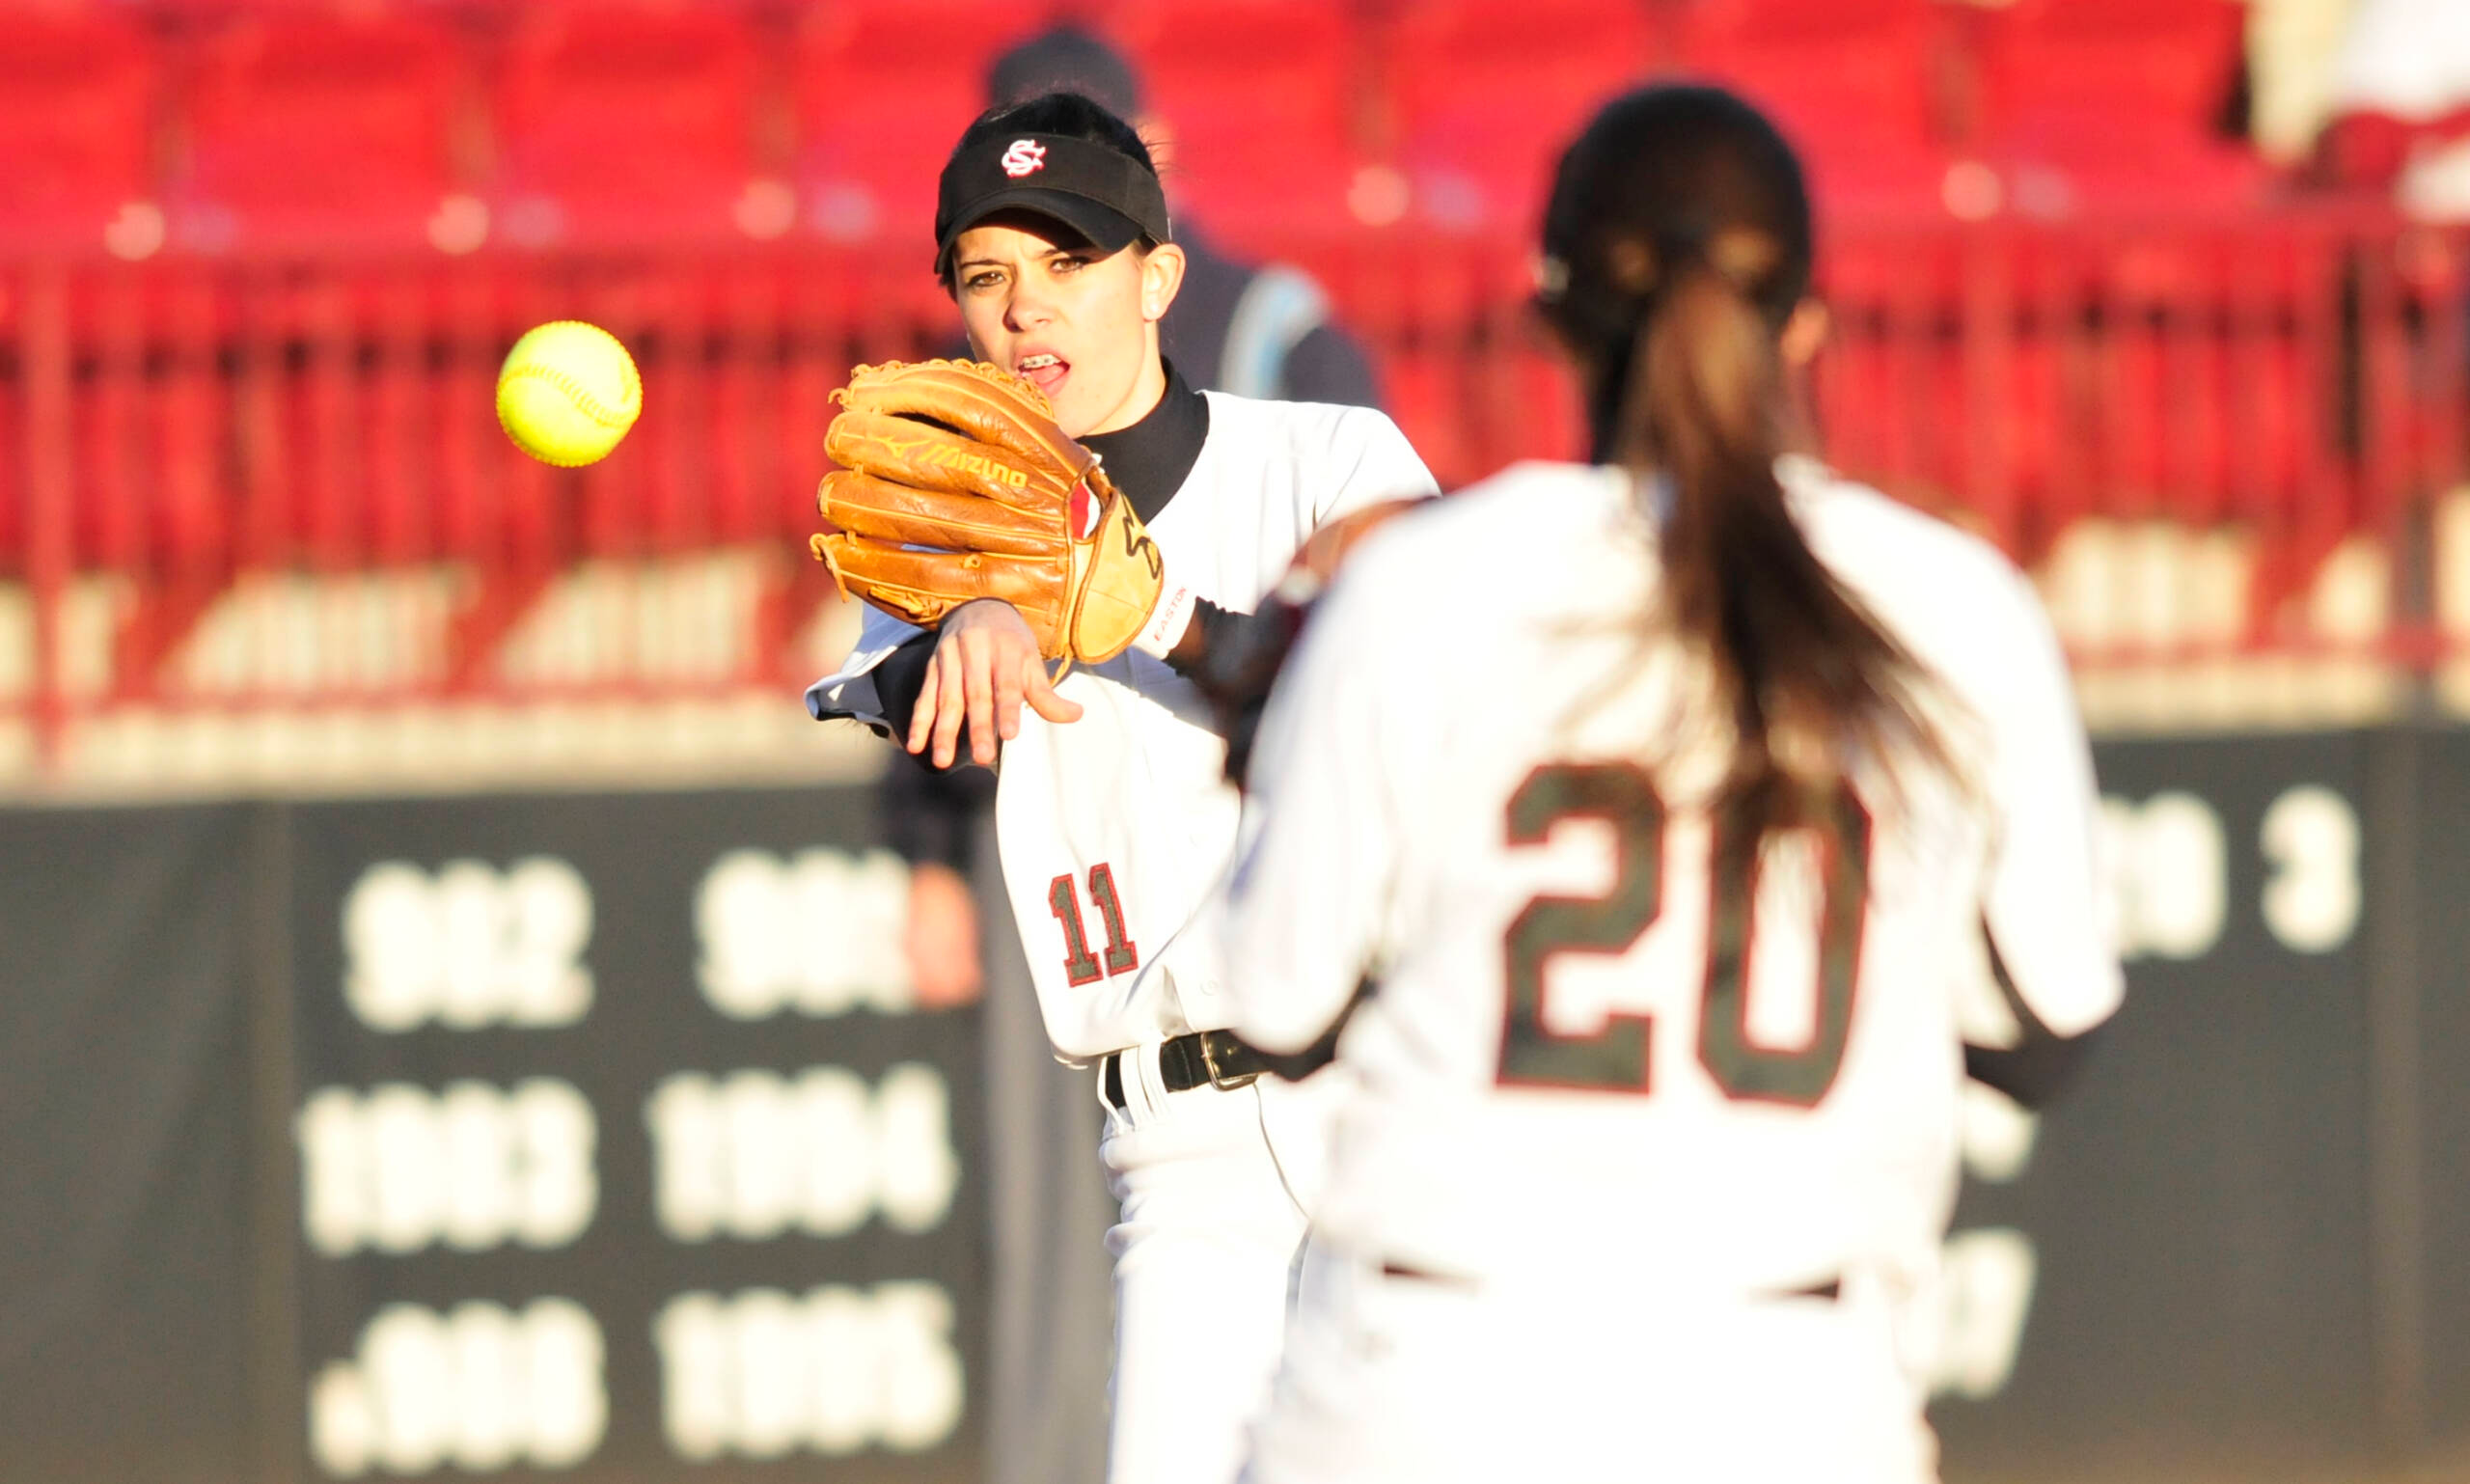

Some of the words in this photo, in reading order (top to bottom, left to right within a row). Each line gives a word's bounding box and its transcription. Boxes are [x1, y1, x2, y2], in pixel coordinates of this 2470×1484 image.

[918, 443, 1028, 488] MIZUNO
[1153, 586, 1188, 642] EASTON
[1048, 862, 1139, 988] 11
[1495, 760, 1873, 1110] 20
